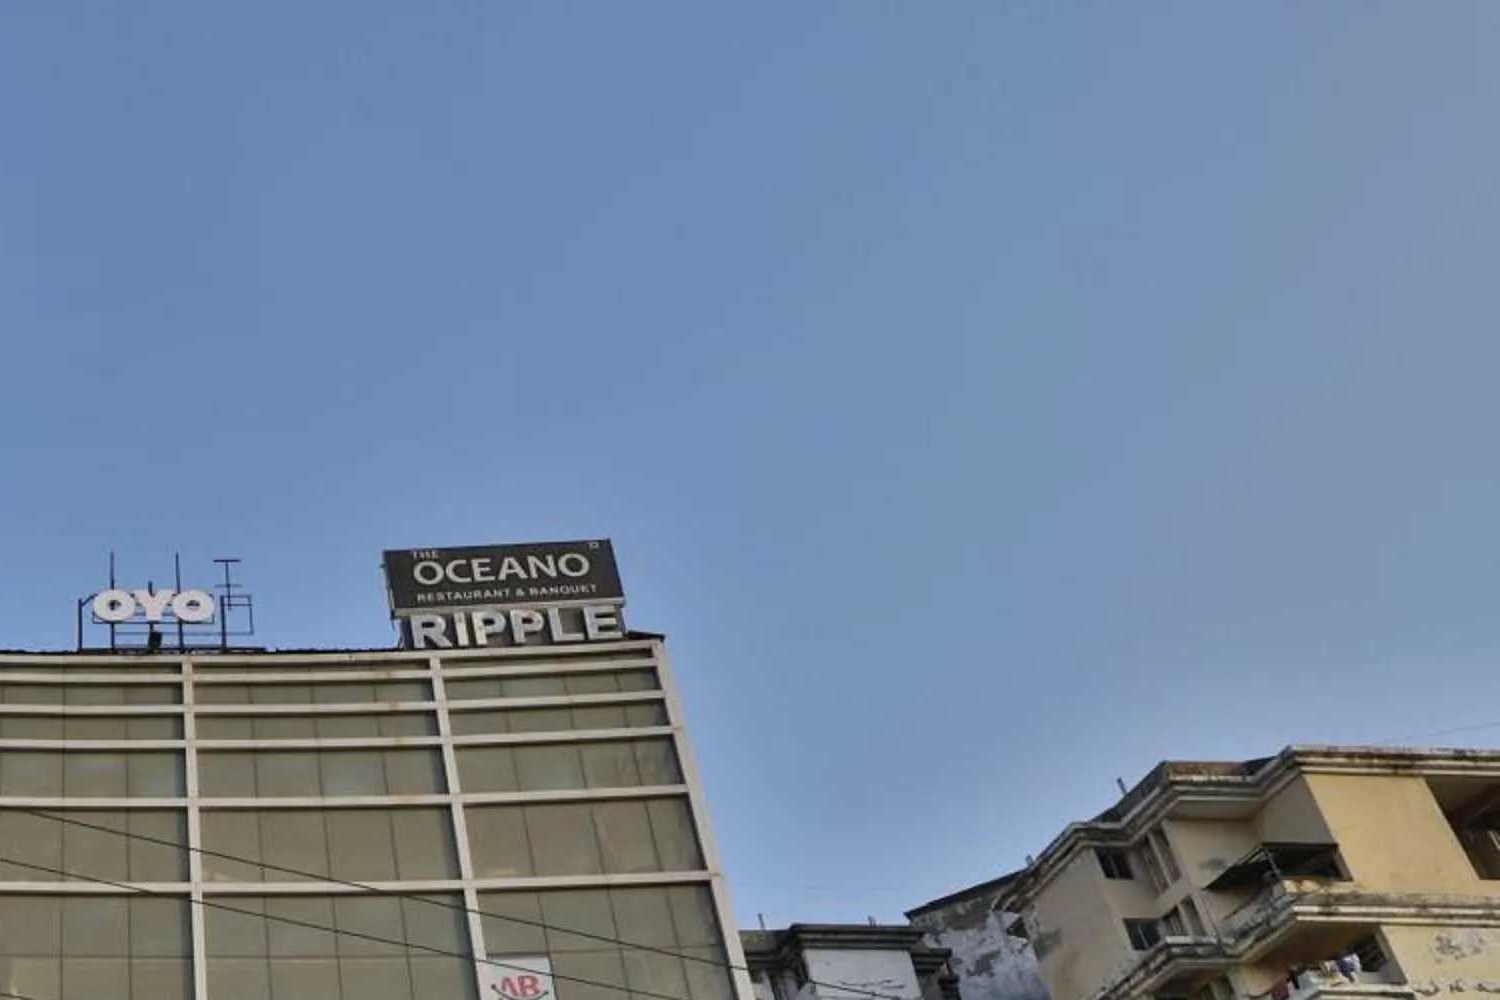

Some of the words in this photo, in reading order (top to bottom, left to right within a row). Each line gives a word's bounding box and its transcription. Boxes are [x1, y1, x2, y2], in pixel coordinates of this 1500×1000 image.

[412, 549, 439, 559] THE
[412, 553, 590, 585] OCEANO
[93, 588, 215, 622] OYO
[416, 587, 510, 601] RESTAURANT
[515, 587, 525, 597] &
[529, 584, 597, 596] BANQUET
[410, 605, 623, 649] RIPPLE
